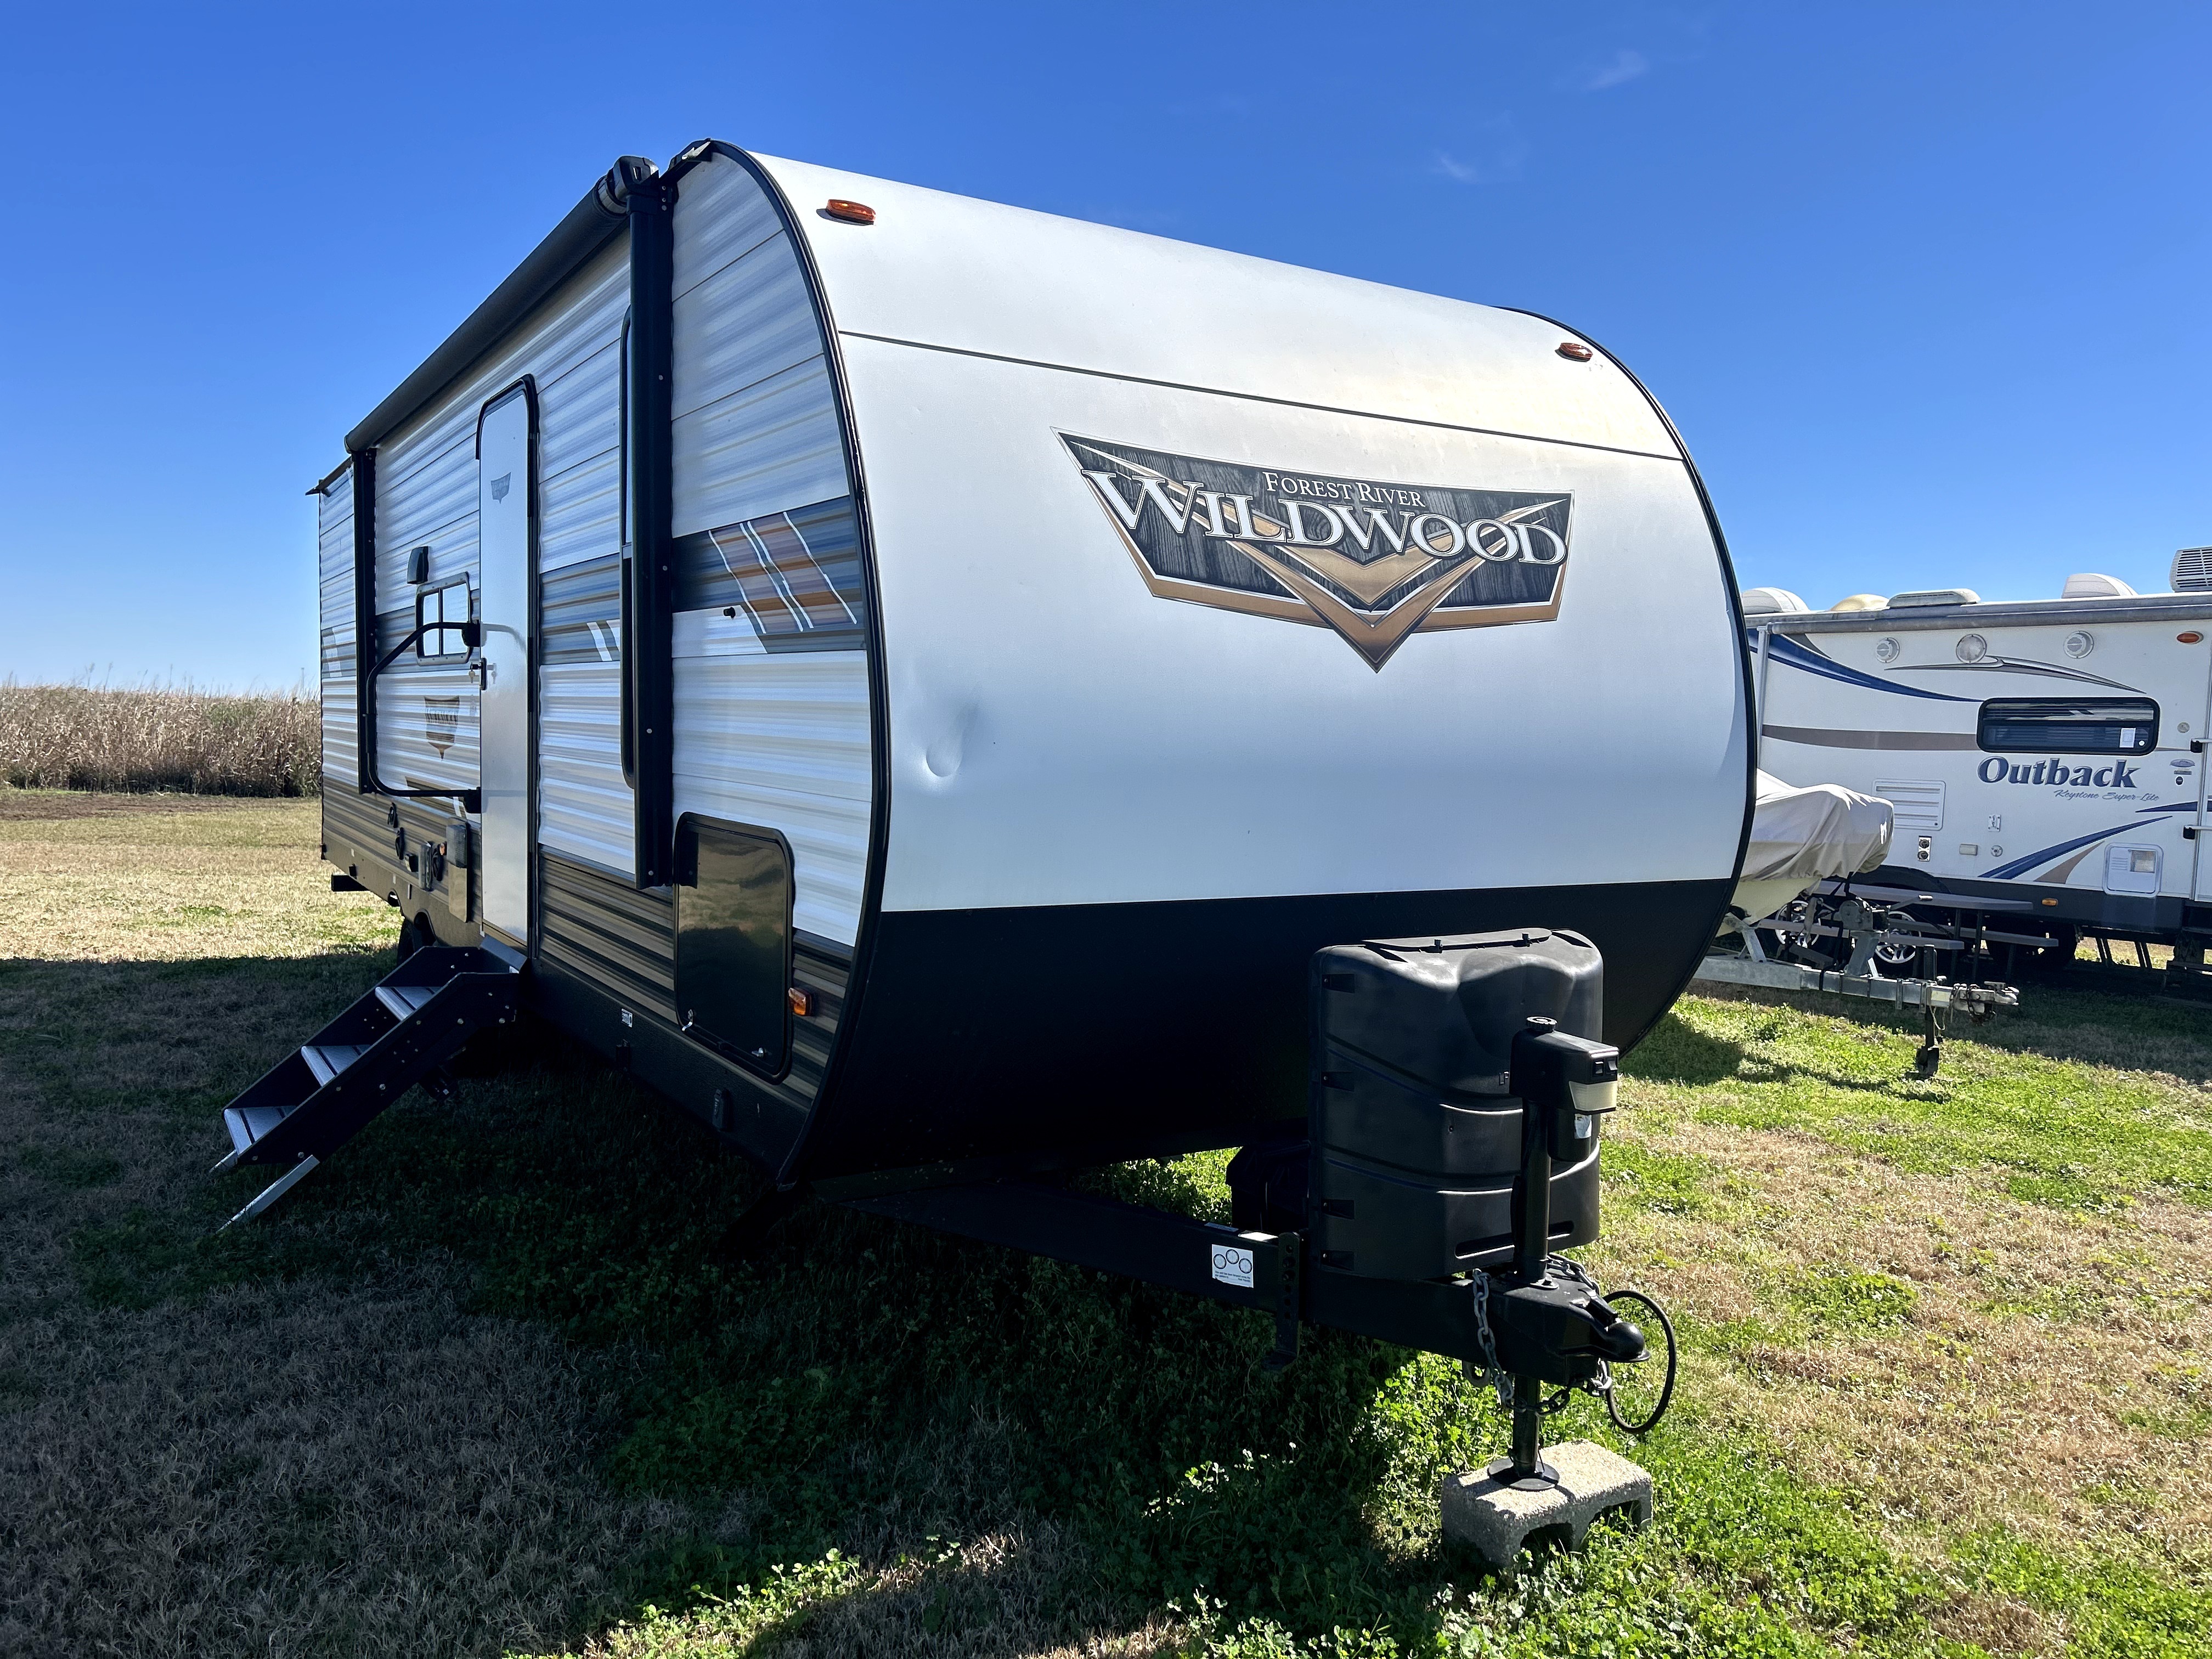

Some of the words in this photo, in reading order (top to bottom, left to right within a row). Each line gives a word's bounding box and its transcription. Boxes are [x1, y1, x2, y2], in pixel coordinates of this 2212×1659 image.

[1262, 471, 1351, 500] FOREST
[1355, 482, 1426, 508] RIVER
[1081, 469, 1568, 566] WILDWOOD
[1977, 755, 2141, 788] Outback
[2053, 789, 2100, 800] Keystone
